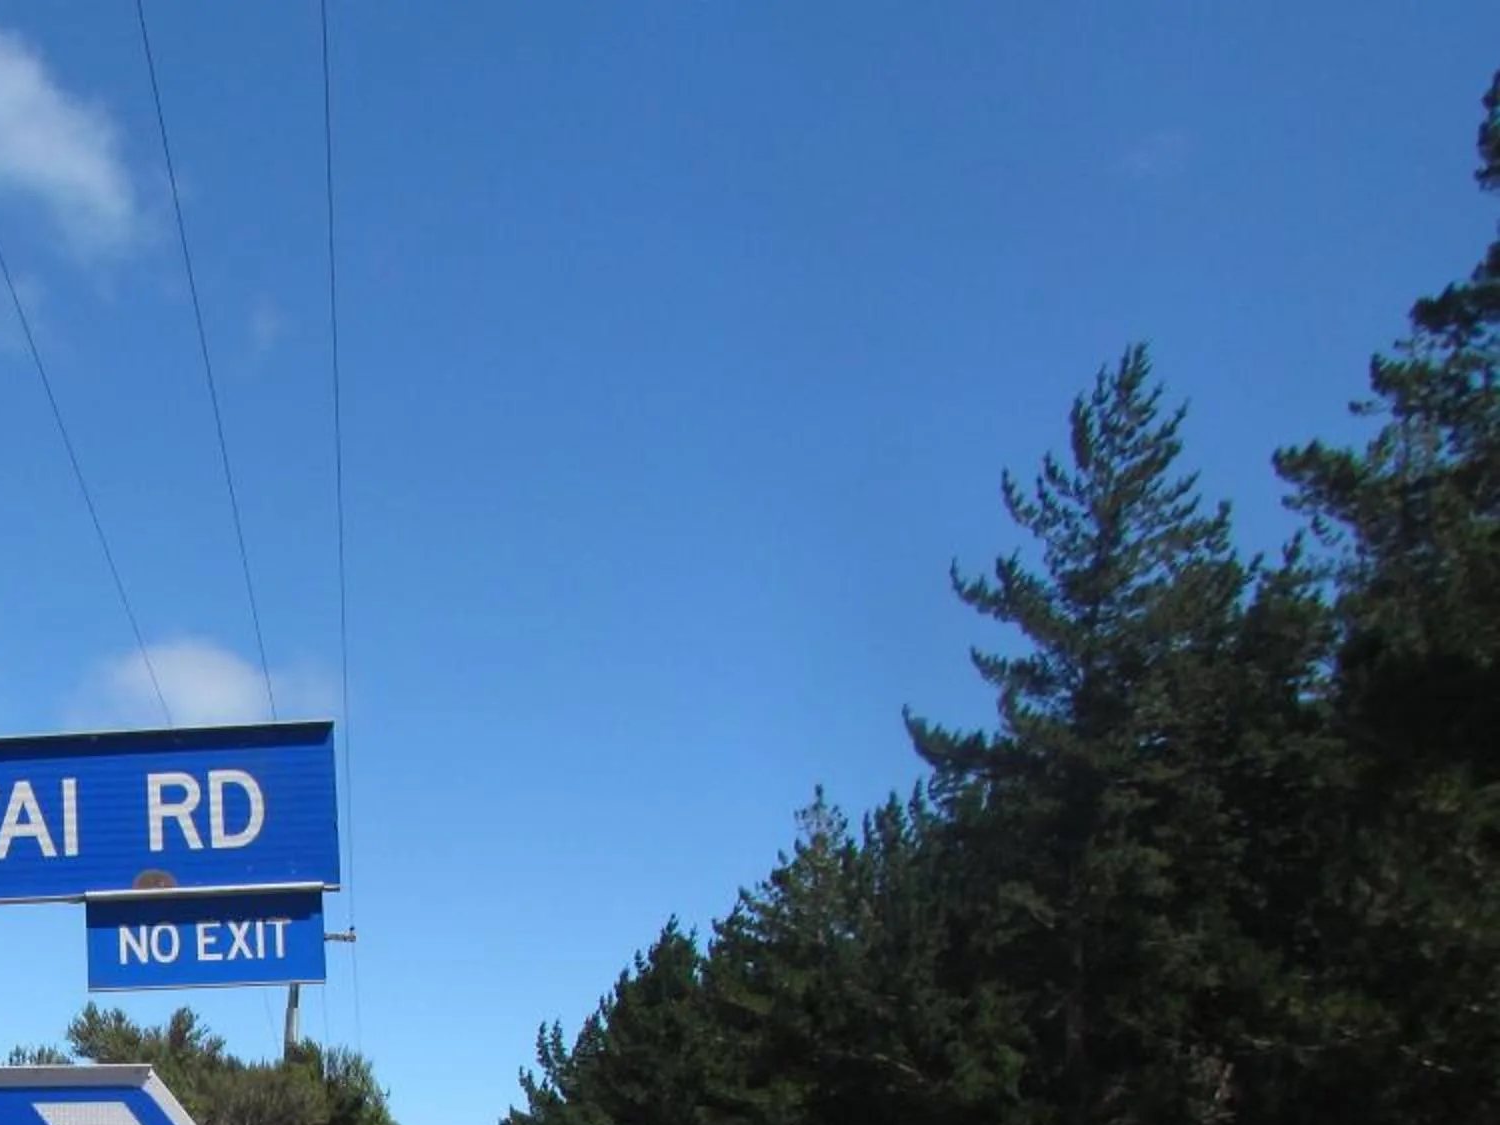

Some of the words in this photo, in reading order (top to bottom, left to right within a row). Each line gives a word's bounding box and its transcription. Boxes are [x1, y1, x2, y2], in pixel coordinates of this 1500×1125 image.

[147, 769, 265, 852] RD
[119, 922, 178, 964] NO
[197, 917, 291, 961] EXIT
